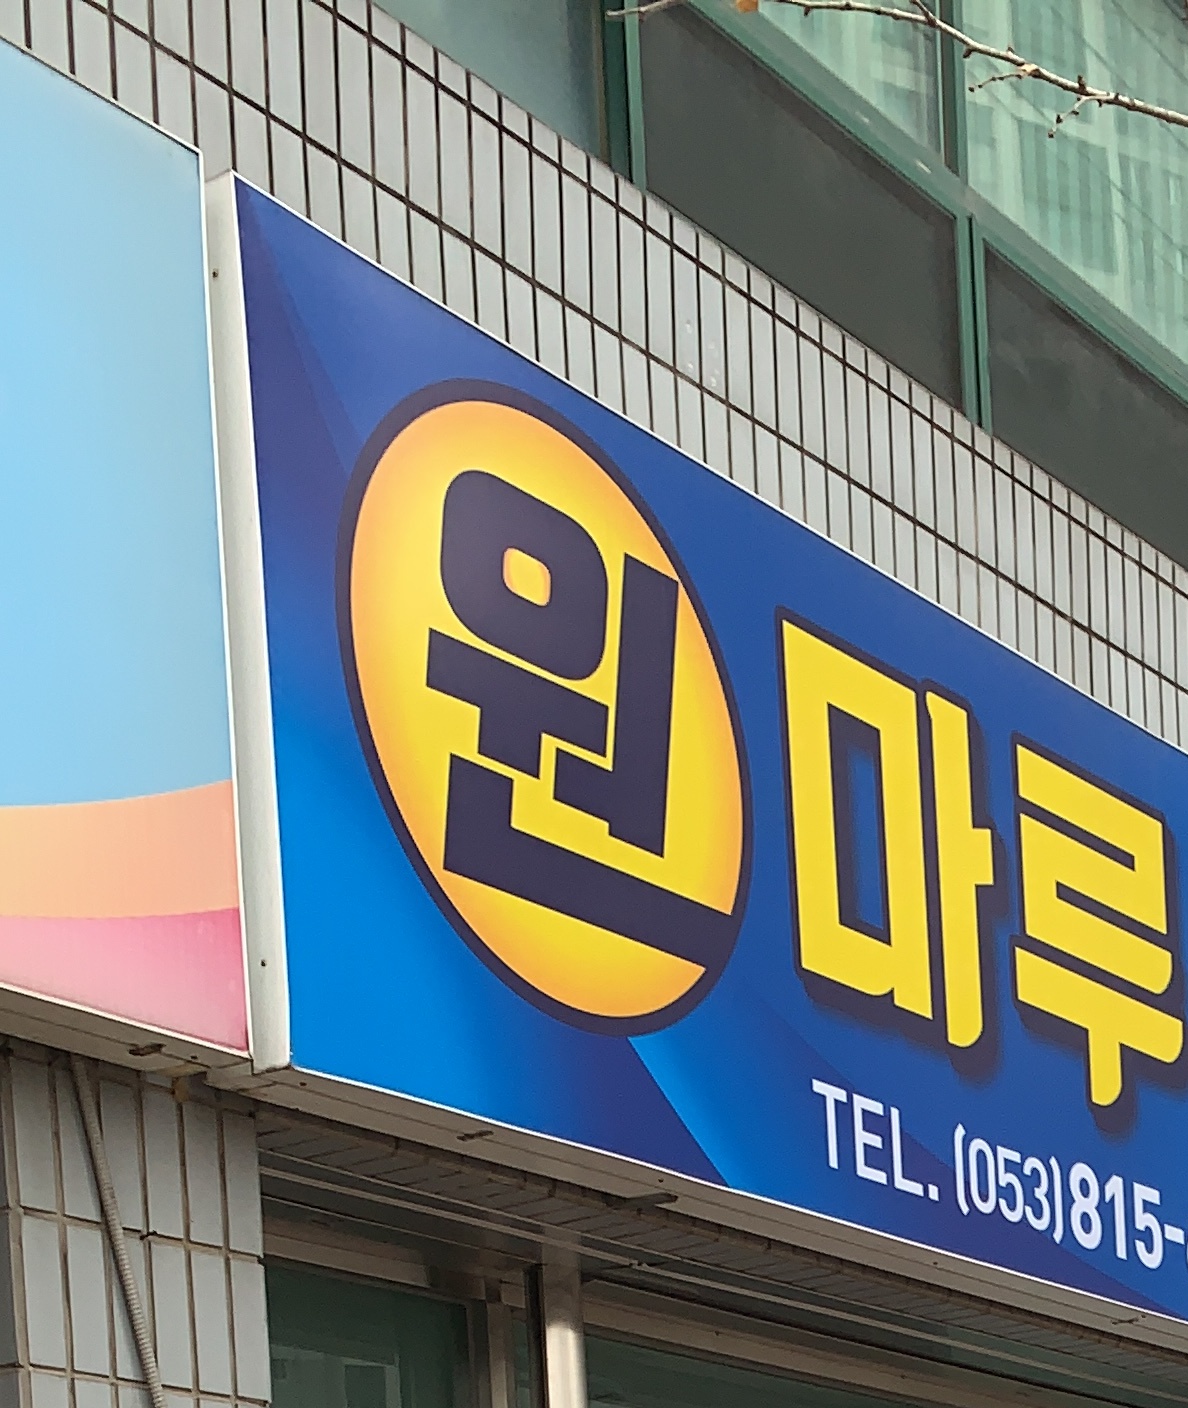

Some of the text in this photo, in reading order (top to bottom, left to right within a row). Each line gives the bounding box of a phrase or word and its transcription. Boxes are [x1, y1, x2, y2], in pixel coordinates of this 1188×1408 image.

[426, 469, 1184, 1108] 원 마루
[811, 1078, 940, 1202] TEL.
